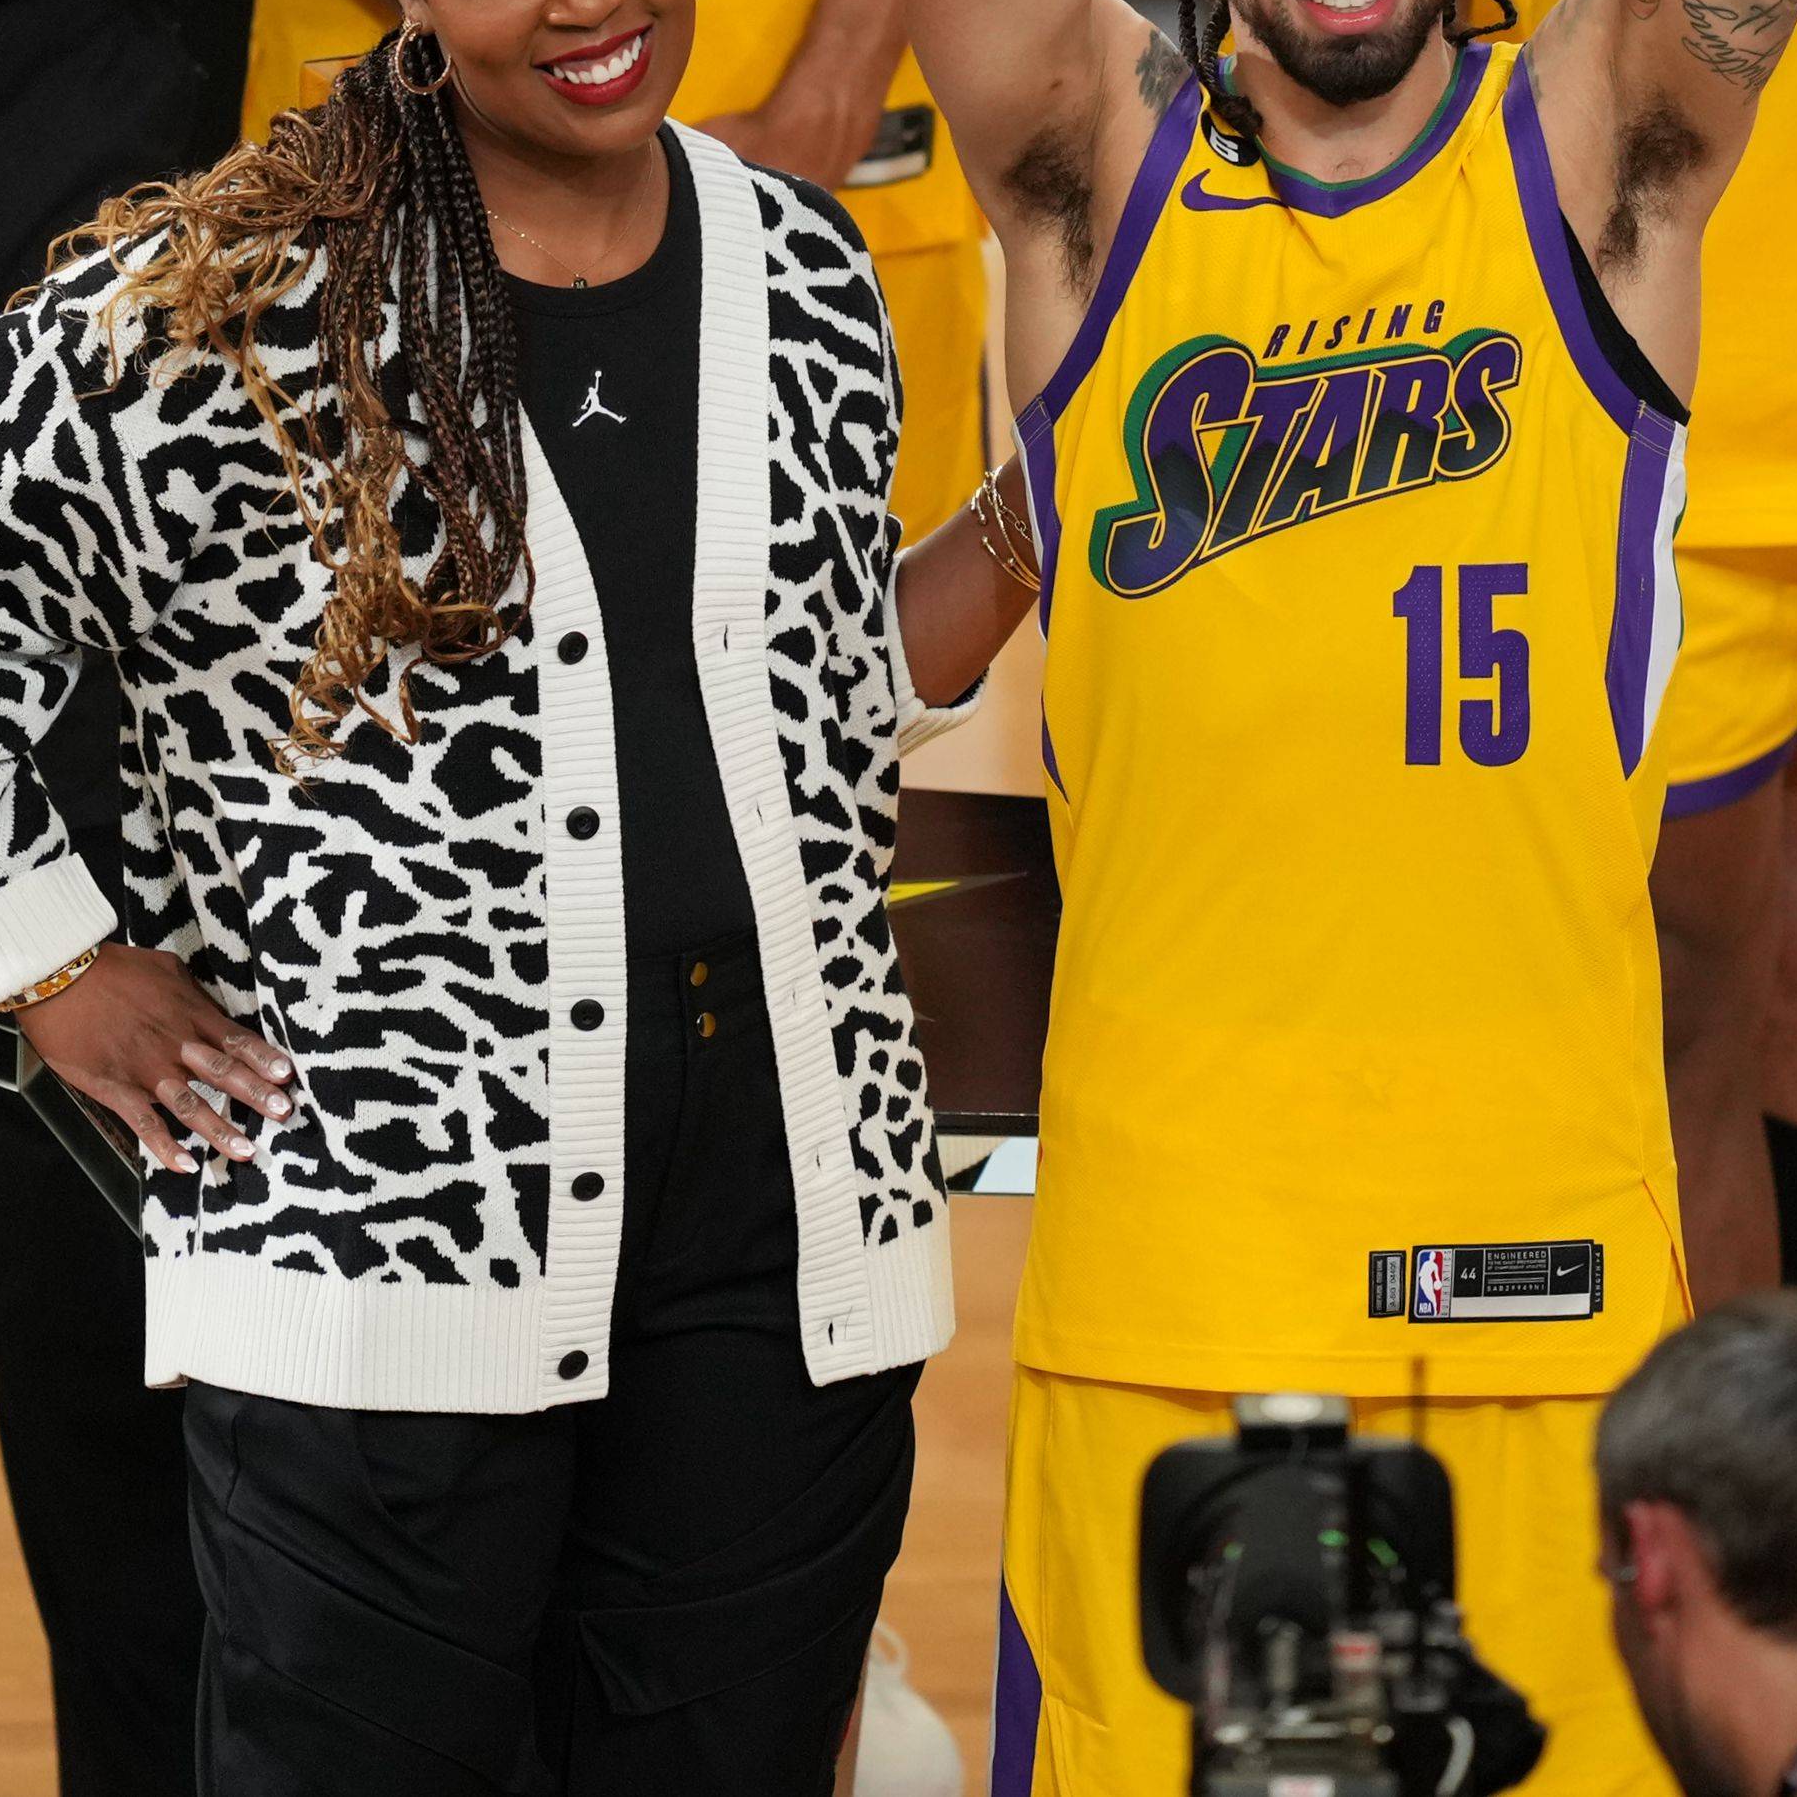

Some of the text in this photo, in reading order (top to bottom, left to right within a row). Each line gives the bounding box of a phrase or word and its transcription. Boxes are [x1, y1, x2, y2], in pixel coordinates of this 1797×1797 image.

[1265, 299, 1444, 358] RISING
[1089, 327, 1522, 600] STARS
[1394, 563, 1529, 767] 15
[1460, 1267, 1477, 1280] 44
[1487, 1250, 1547, 1261] ENGINEERED
[1418, 1302, 1432, 1314] NBA
